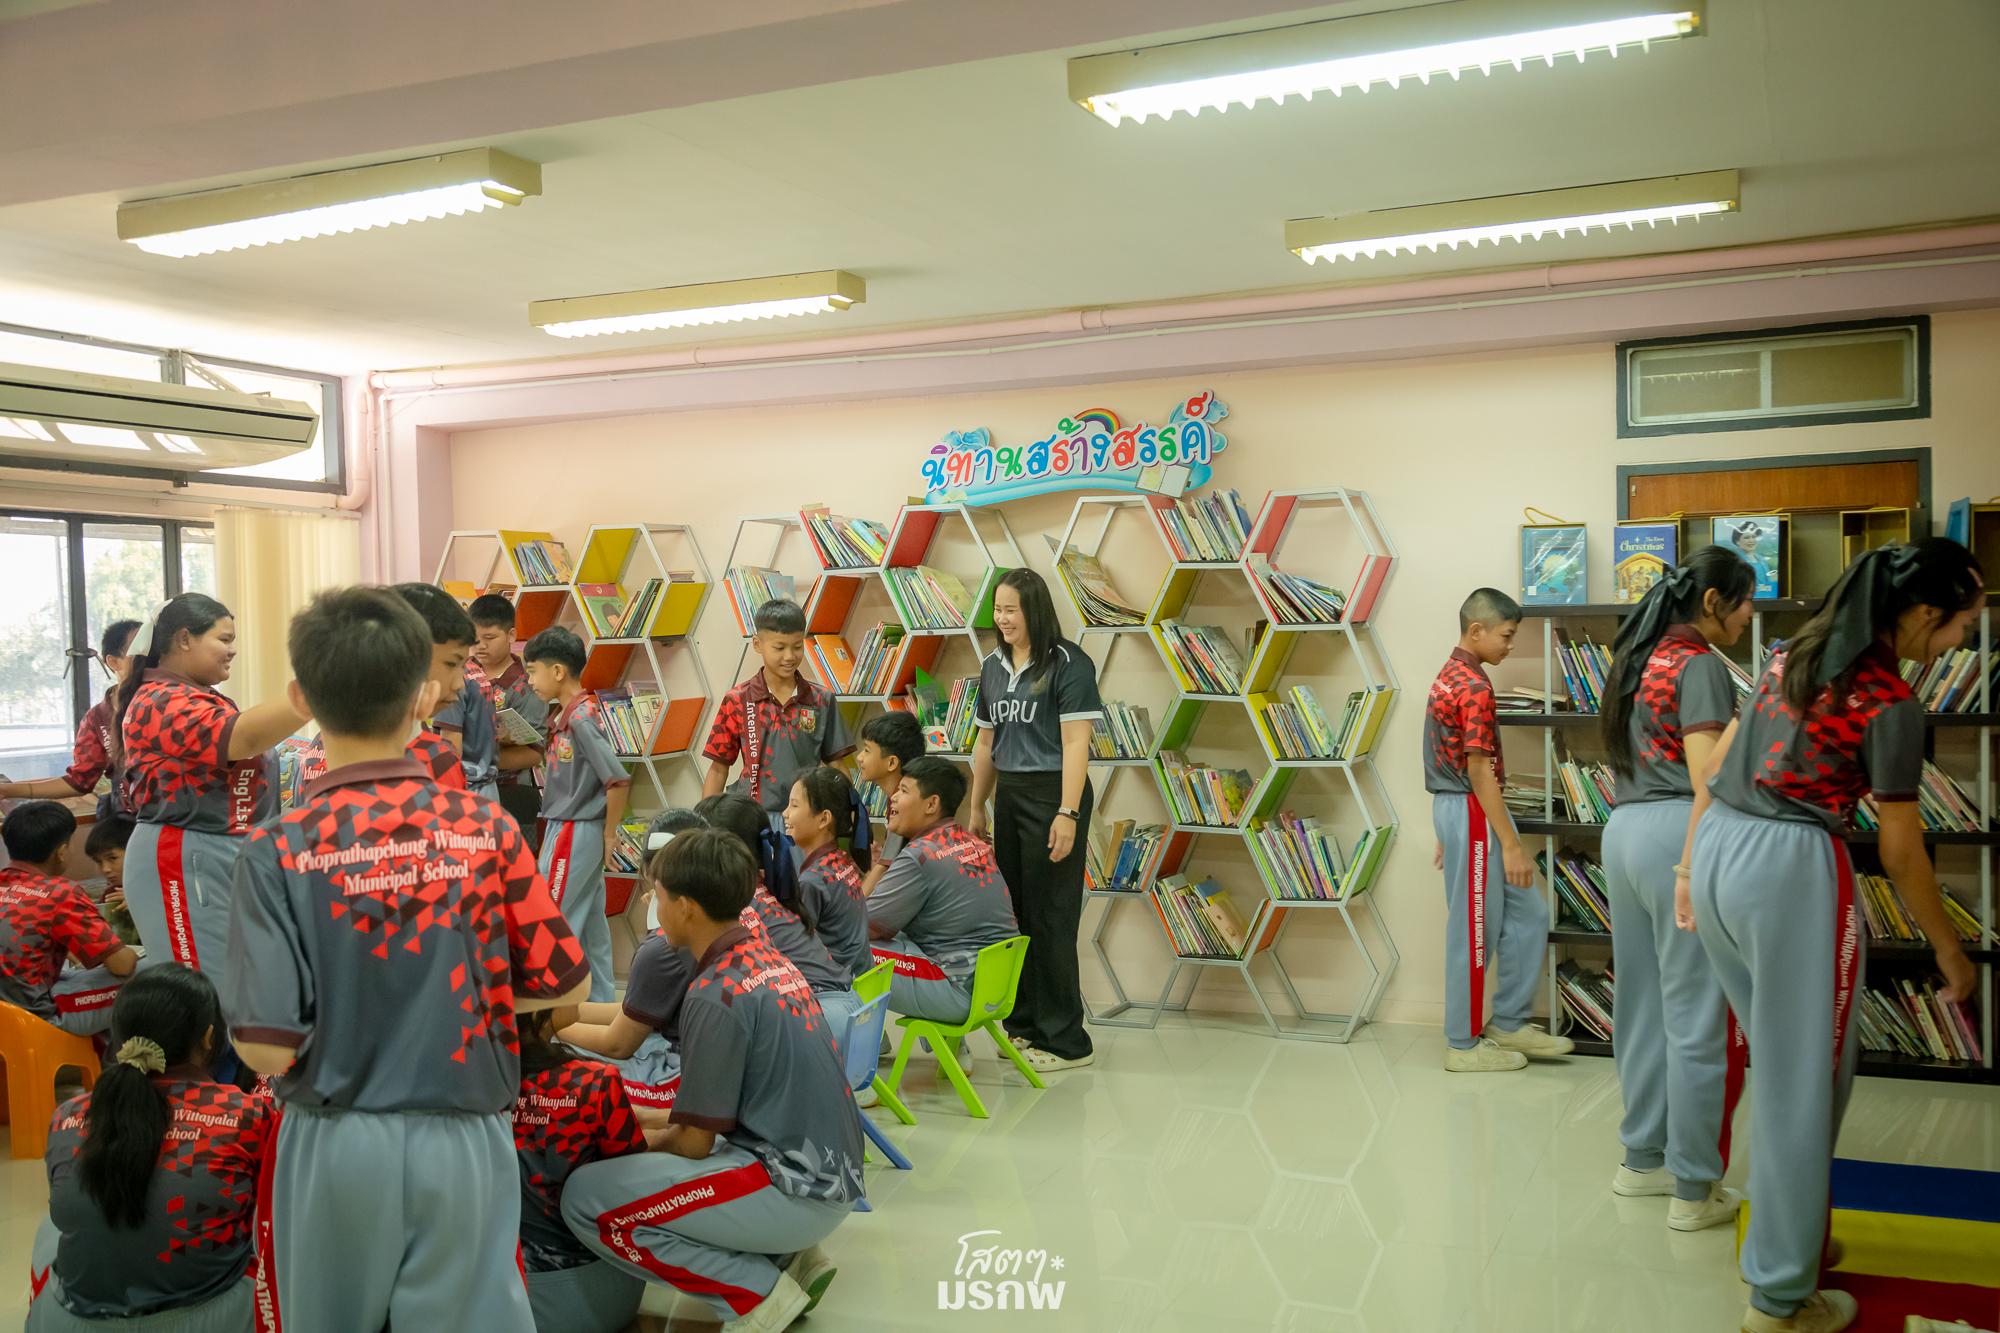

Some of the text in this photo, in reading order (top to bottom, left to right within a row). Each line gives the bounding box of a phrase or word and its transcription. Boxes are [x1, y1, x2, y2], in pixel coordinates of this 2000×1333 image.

[920, 391, 1208, 489] นิทานสร้างสรรค์
[1619, 539, 1665, 551] Christmas
[746, 701, 760, 758] Intensive
[296, 838, 429, 875] Phoprathapchang
[342, 859, 469, 897] Municipal School
[169, 880, 191, 960] PHOPRATHAPCHANG
[529, 1094, 578, 1111] Wittayalai
[173, 1108, 239, 1128] Wittayalai
[520, 1112, 551, 1125] School
[165, 1127, 202, 1141] chool
